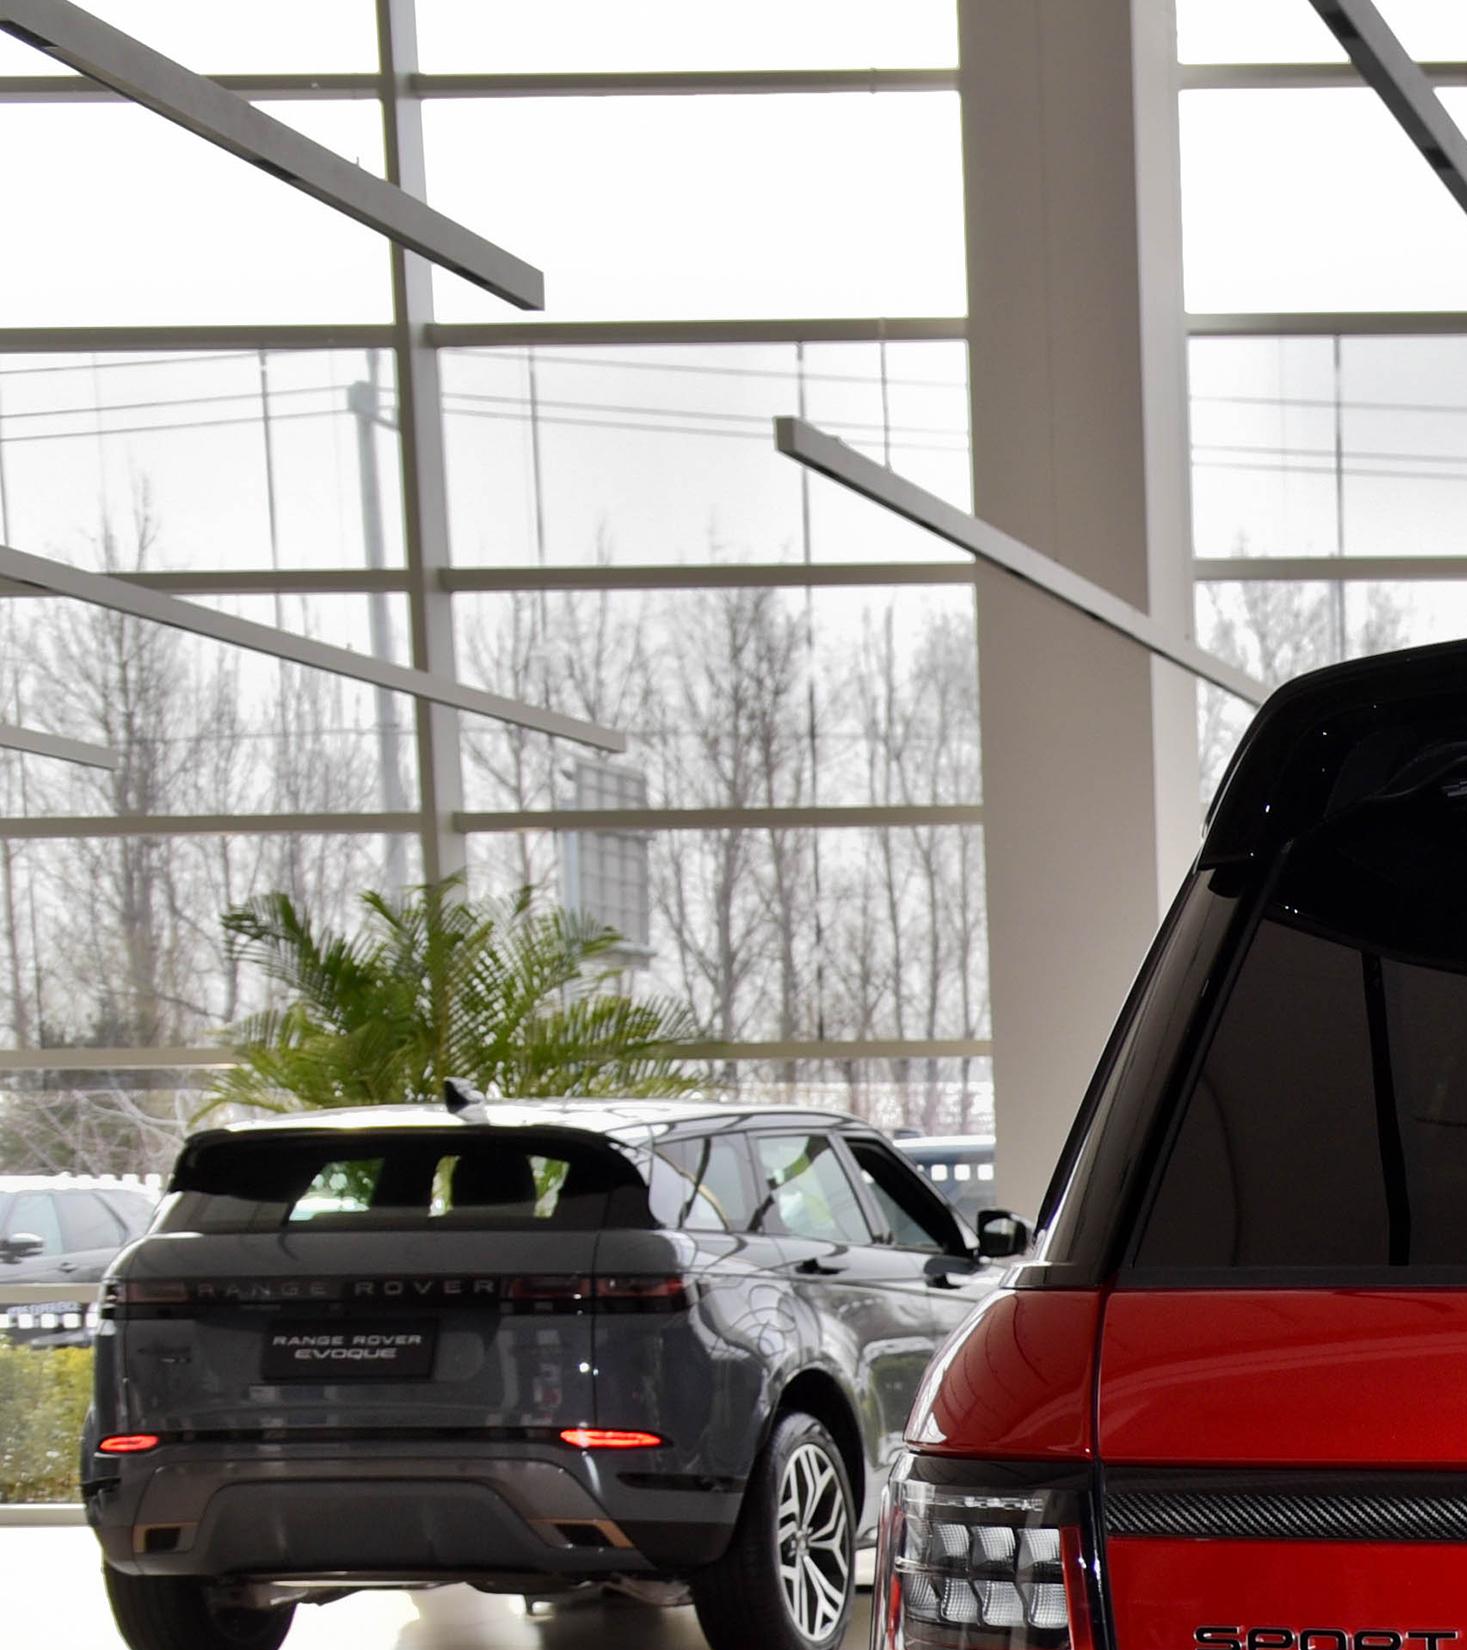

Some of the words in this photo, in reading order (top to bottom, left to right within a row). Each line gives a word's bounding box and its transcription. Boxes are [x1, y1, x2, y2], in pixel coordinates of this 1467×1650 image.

[198, 1281, 328, 1297] RANGE
[354, 1279, 495, 1295] ROVER
[272, 1335, 344, 1346] RANGE
[352, 1334, 422, 1345] ROVER
[294, 1348, 398, 1360] EVOQUE
